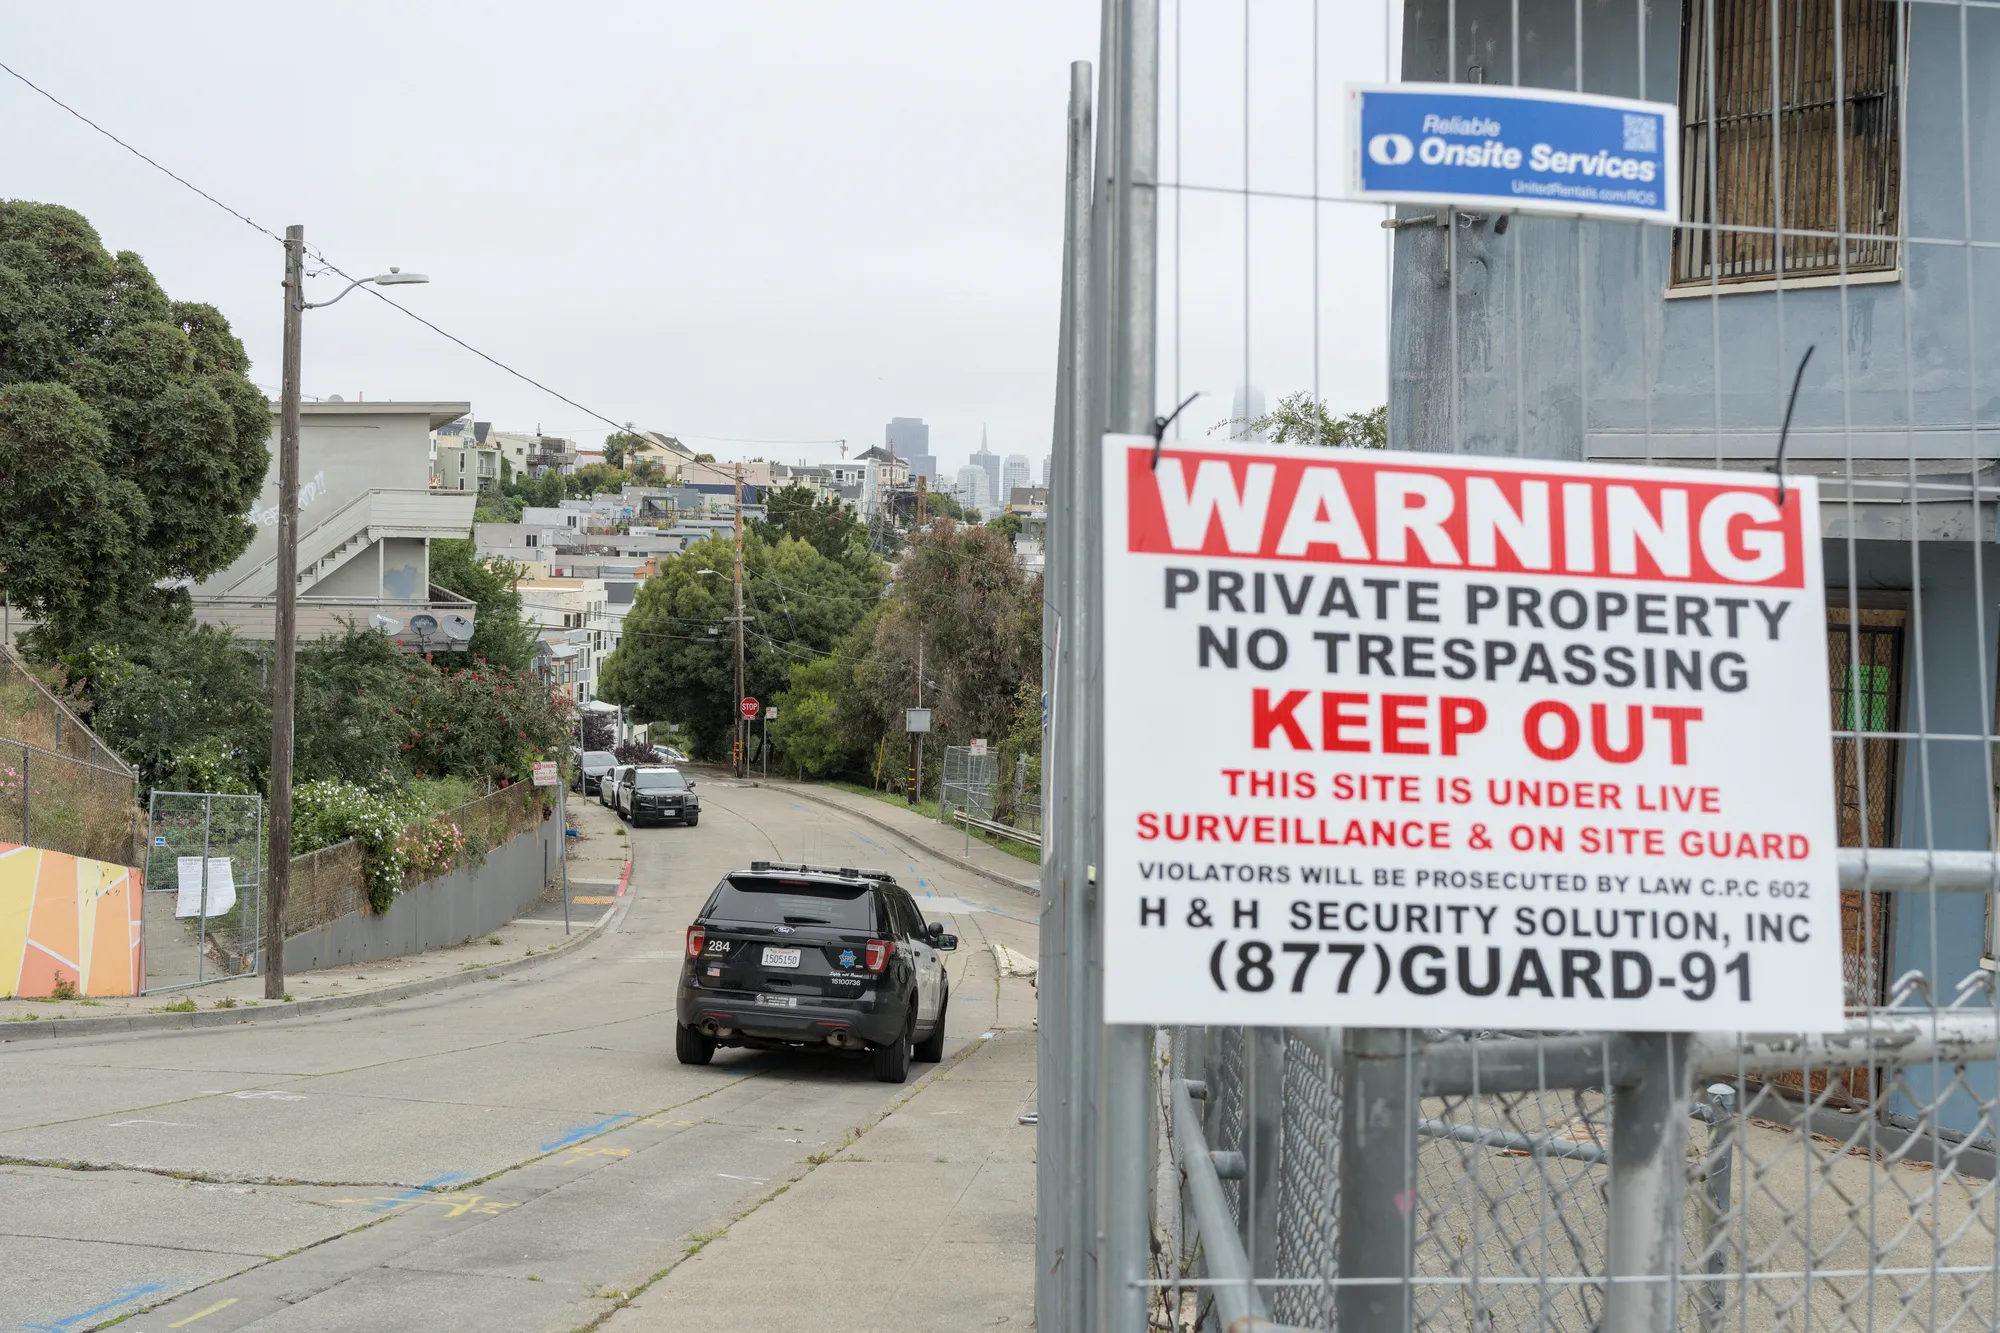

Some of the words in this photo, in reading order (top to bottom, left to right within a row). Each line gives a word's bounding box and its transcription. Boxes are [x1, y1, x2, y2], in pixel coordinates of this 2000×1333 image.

[1423, 114, 1501, 138] Reliable
[1419, 137, 1523, 170] Onsite
[1528, 143, 1656, 182] Services
[1511, 179, 1657, 206] UnitedRentals.com/ROS
[1153, 456, 1786, 582] WARNING
[1163, 566, 1441, 623] PRIVATE
[1466, 583, 1791, 641] PROPERTY
[1198, 624, 1288, 672] NO
[1313, 631, 1749, 693] TRESPASSING
[741, 703, 758, 711] STOP
[1251, 687, 1488, 756] KEEP
[1523, 699, 1703, 766] OUT
[1221, 769, 1317, 799] THIS
[1332, 773, 1421, 803] SITE
[1437, 777, 1472, 804] IS
[1488, 778, 1622, 810] UNDER
[1637, 784, 1721, 814] LIVE
[1136, 812, 1451, 850] SURVEILLANCE
[1467, 822, 1493, 851] &
[1510, 824, 1564, 852] ON
[1580, 827, 1665, 856] SITE
[1680, 830, 1810, 860] GUARD
[1139, 861, 1291, 884] VIOLATORS
[1301, 867, 1363, 886] WILL
[1374, 869, 1406, 888] BE
[1416, 870, 1587, 892] PROSECUTED
[1597, 875, 1630, 894] BY
[1639, 877, 1692, 896] LAW
[1701, 879, 1760, 898] C.P.C
[1768, 880, 1810, 899] 602
[1139, 897, 1167, 927] H
[1186, 897, 1214, 928] &
[1232, 899, 1260, 929] H
[1289, 900, 1499, 935] SECURITY
[1514, 906, 1730, 948] SOLUTION,
[1746, 913, 1811, 943] INC
[708, 940, 731, 952] 284
[764, 954, 798, 965] 1505150
[831, 978, 861, 986] 16100736
[1209, 939, 1752, 1003] (877)GUARD-91
